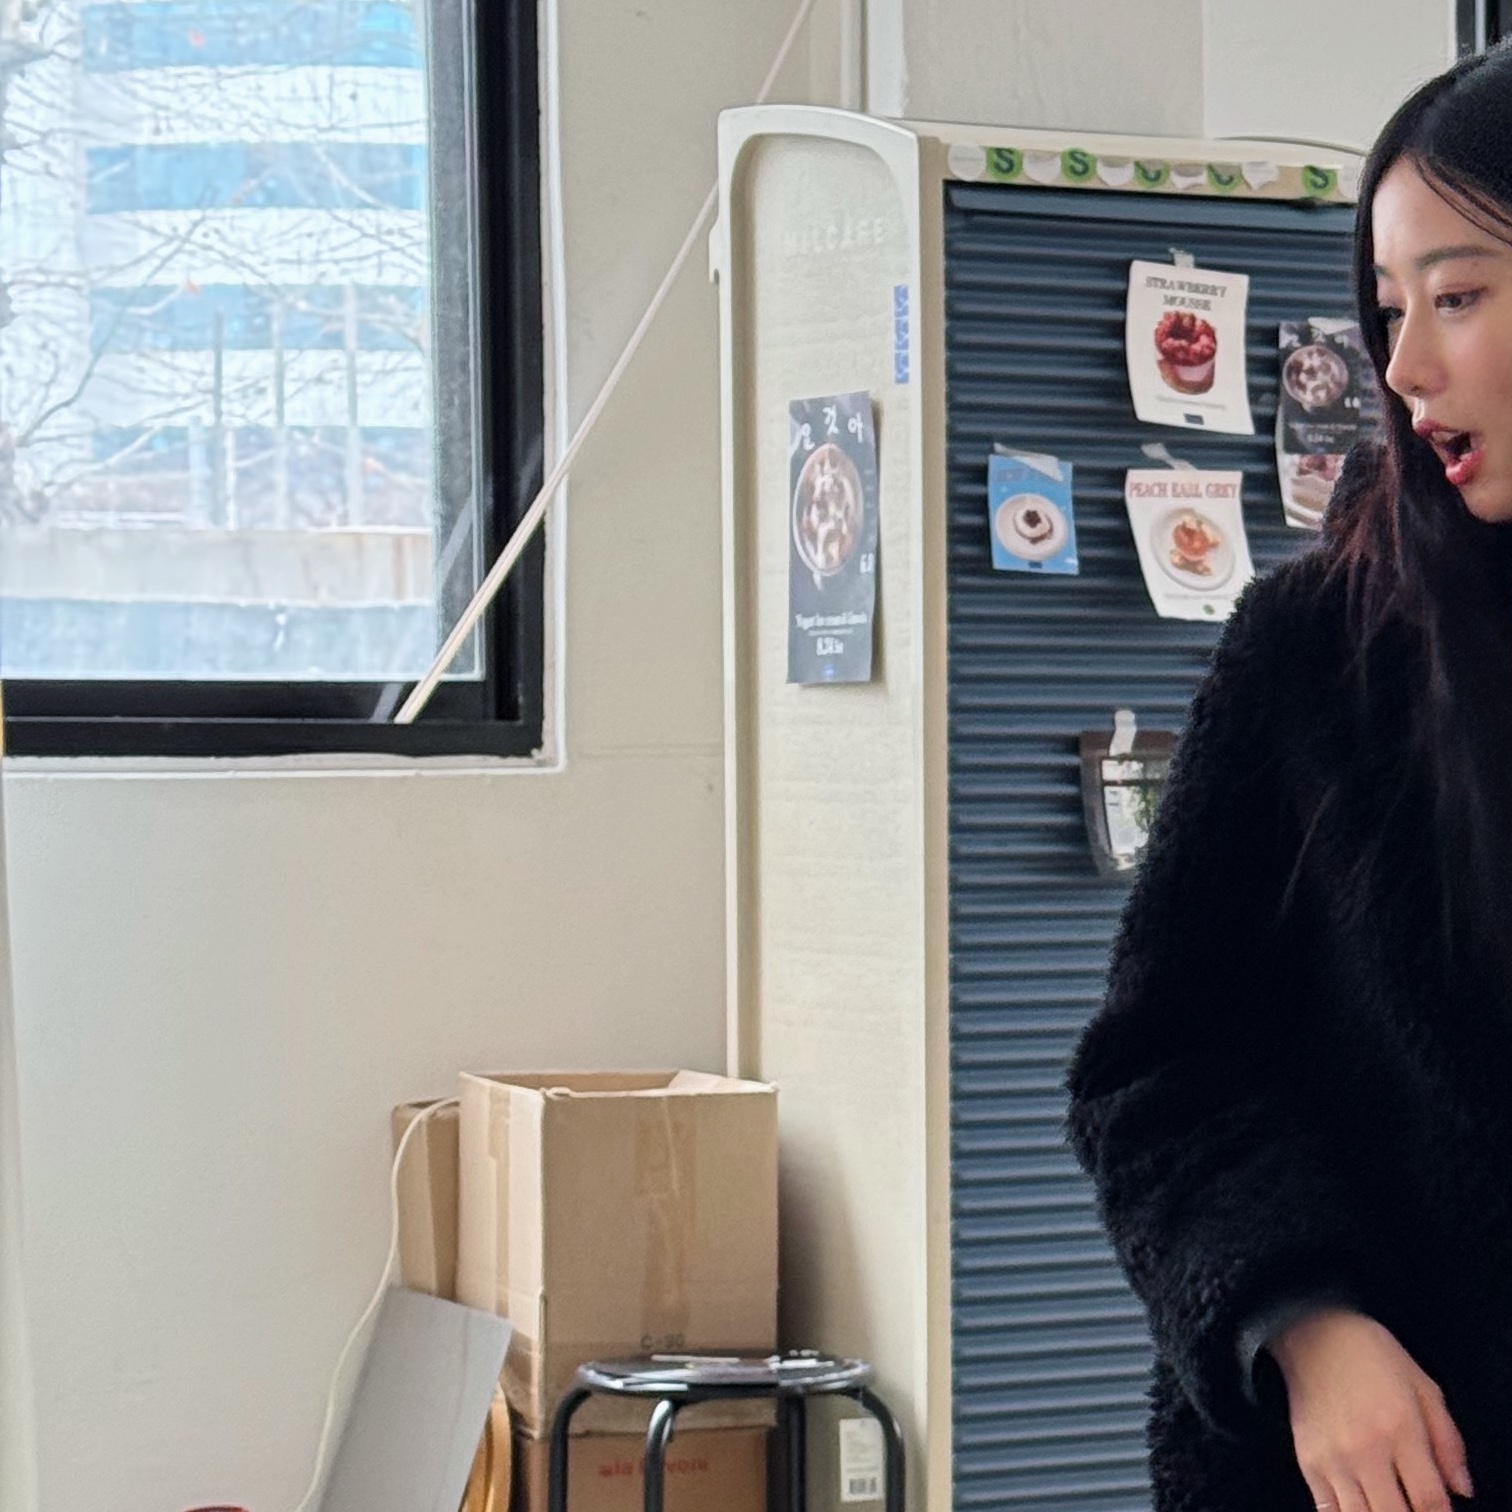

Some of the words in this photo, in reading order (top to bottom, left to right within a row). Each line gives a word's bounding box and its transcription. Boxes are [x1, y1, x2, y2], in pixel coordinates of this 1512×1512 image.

[1145, 276, 1227, 298] STRAWBERRY
[1129, 482, 1168, 498] PEACH
[1171, 482, 1203, 498] EARL
[1205, 482, 1238, 499] GREY
